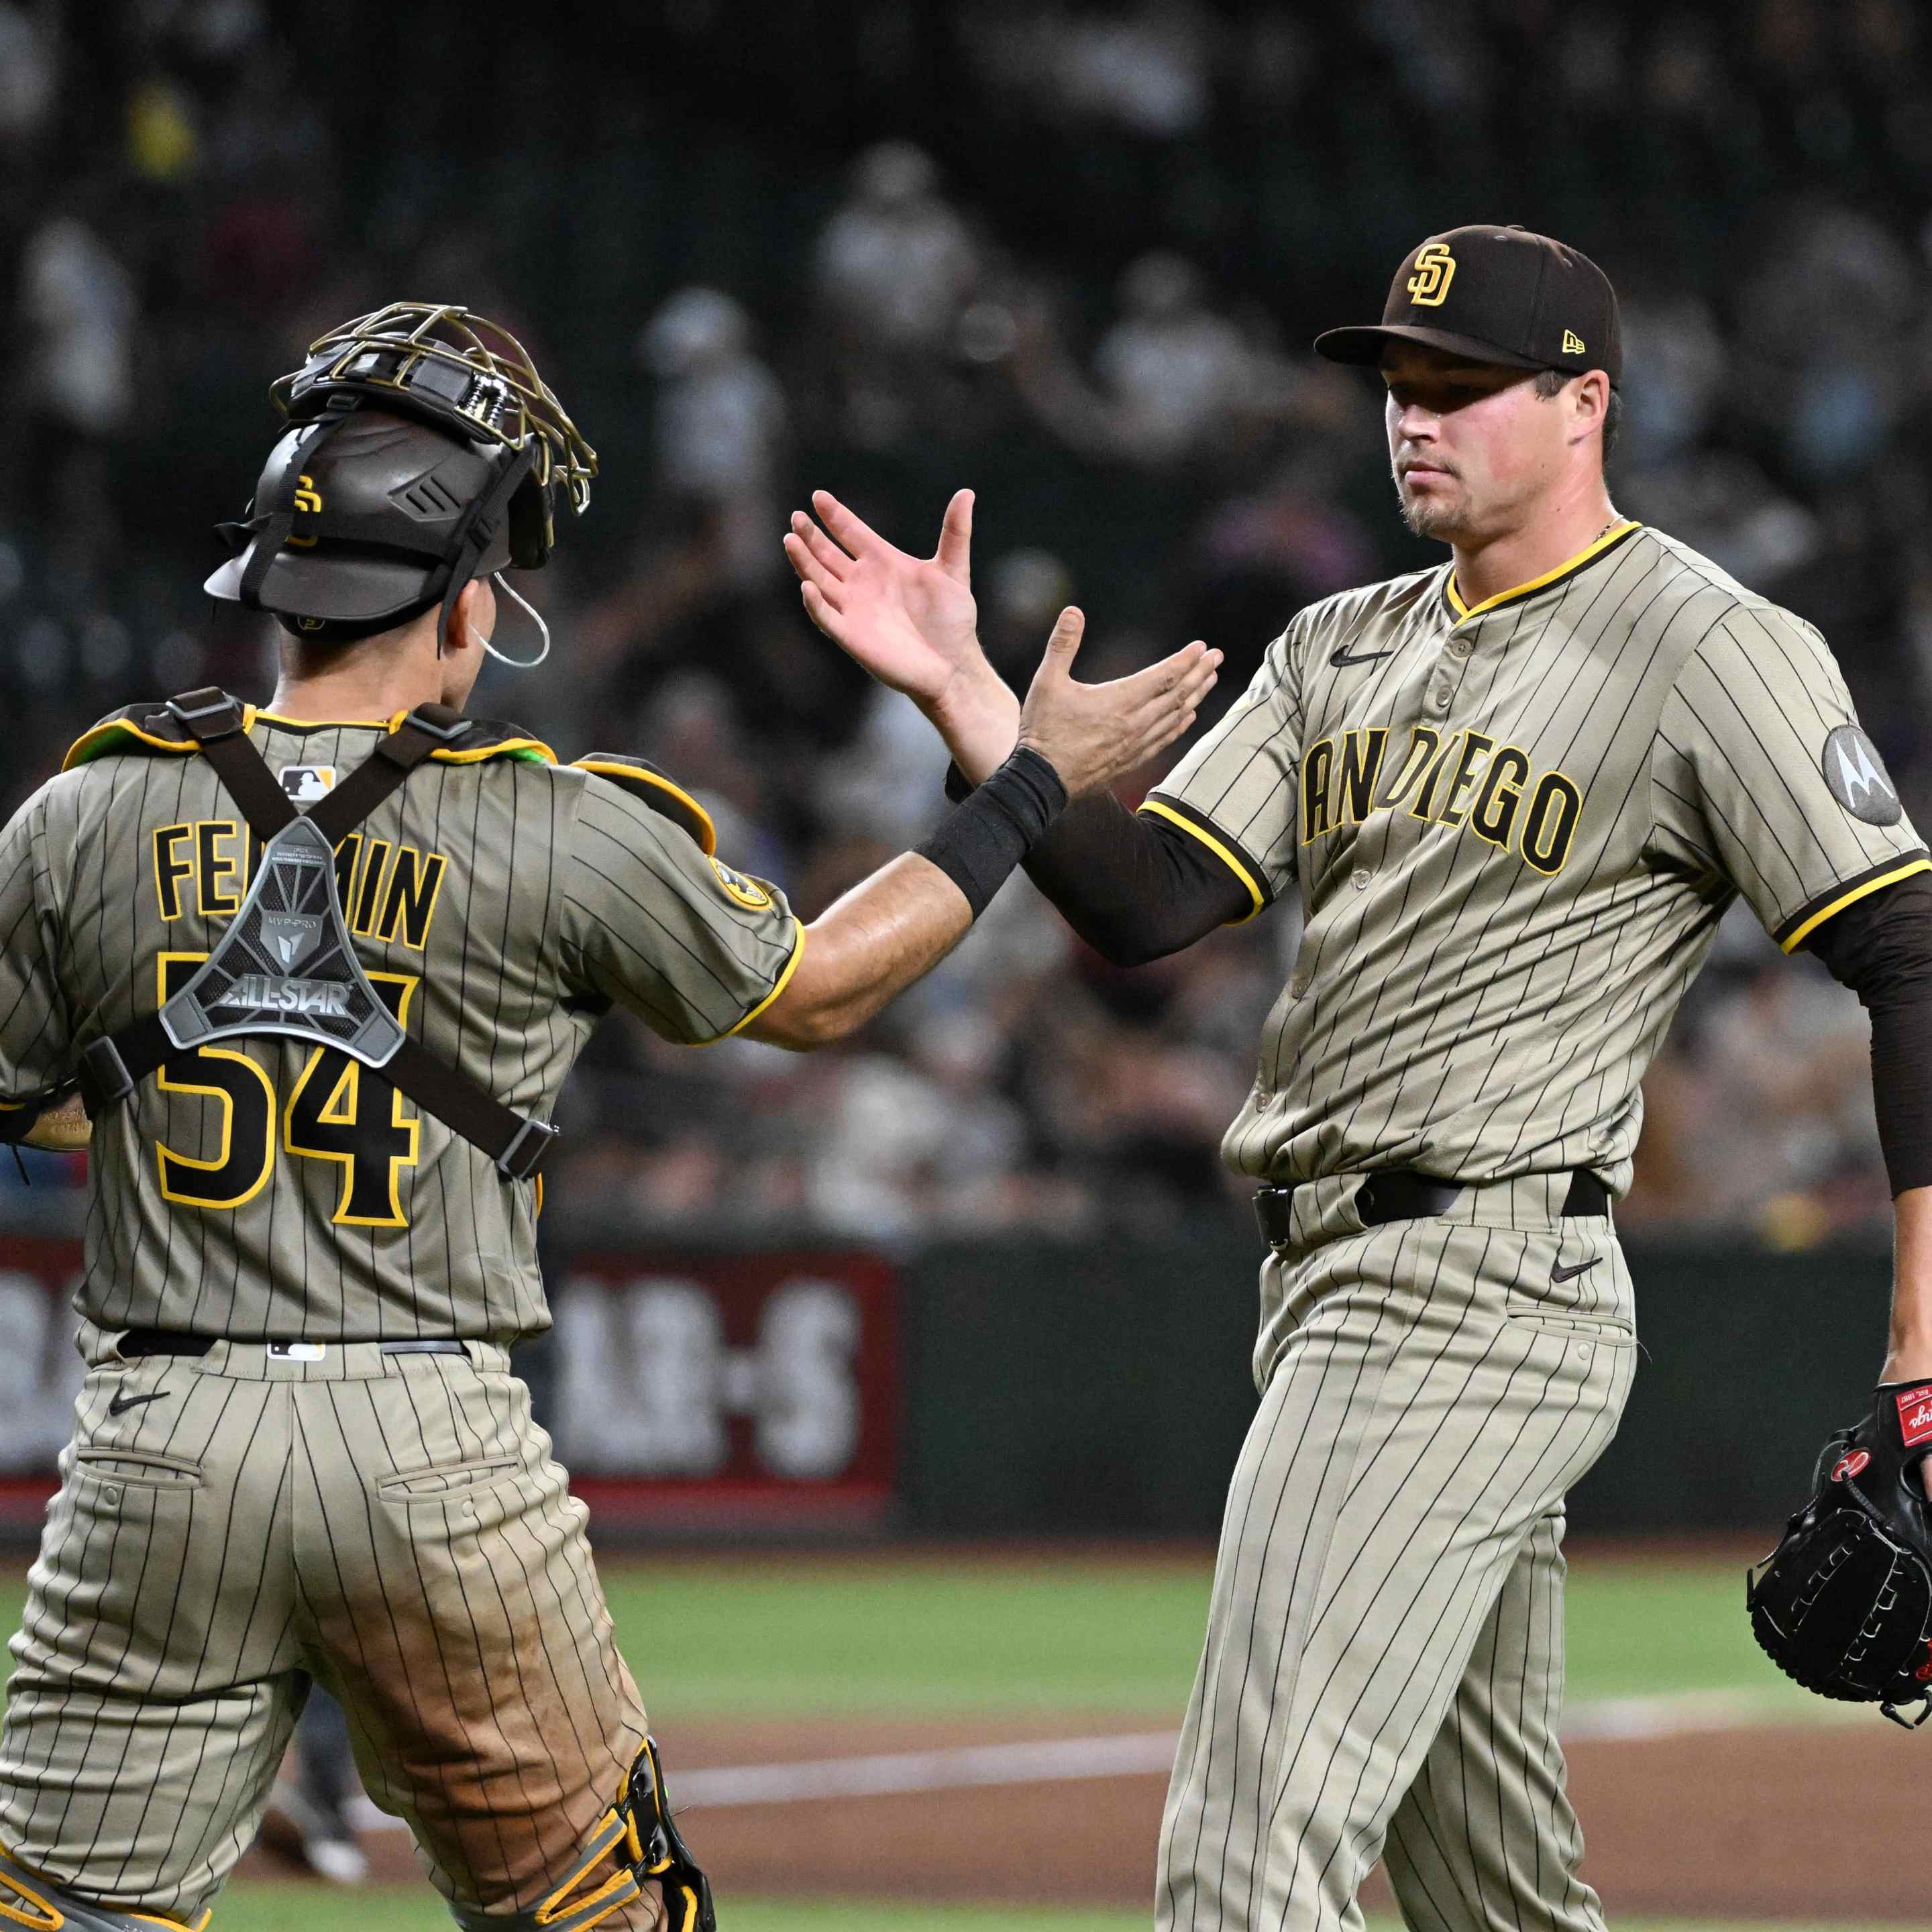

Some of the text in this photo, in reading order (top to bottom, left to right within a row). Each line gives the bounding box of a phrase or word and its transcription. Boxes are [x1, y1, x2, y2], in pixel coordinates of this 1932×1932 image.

[1407, 244, 1456, 307] SD
[1373, 725, 1583, 875] DIEGO
[219, 975, 350, 1016] ALL-STAR
[156, 951, 421, 1228] 54
